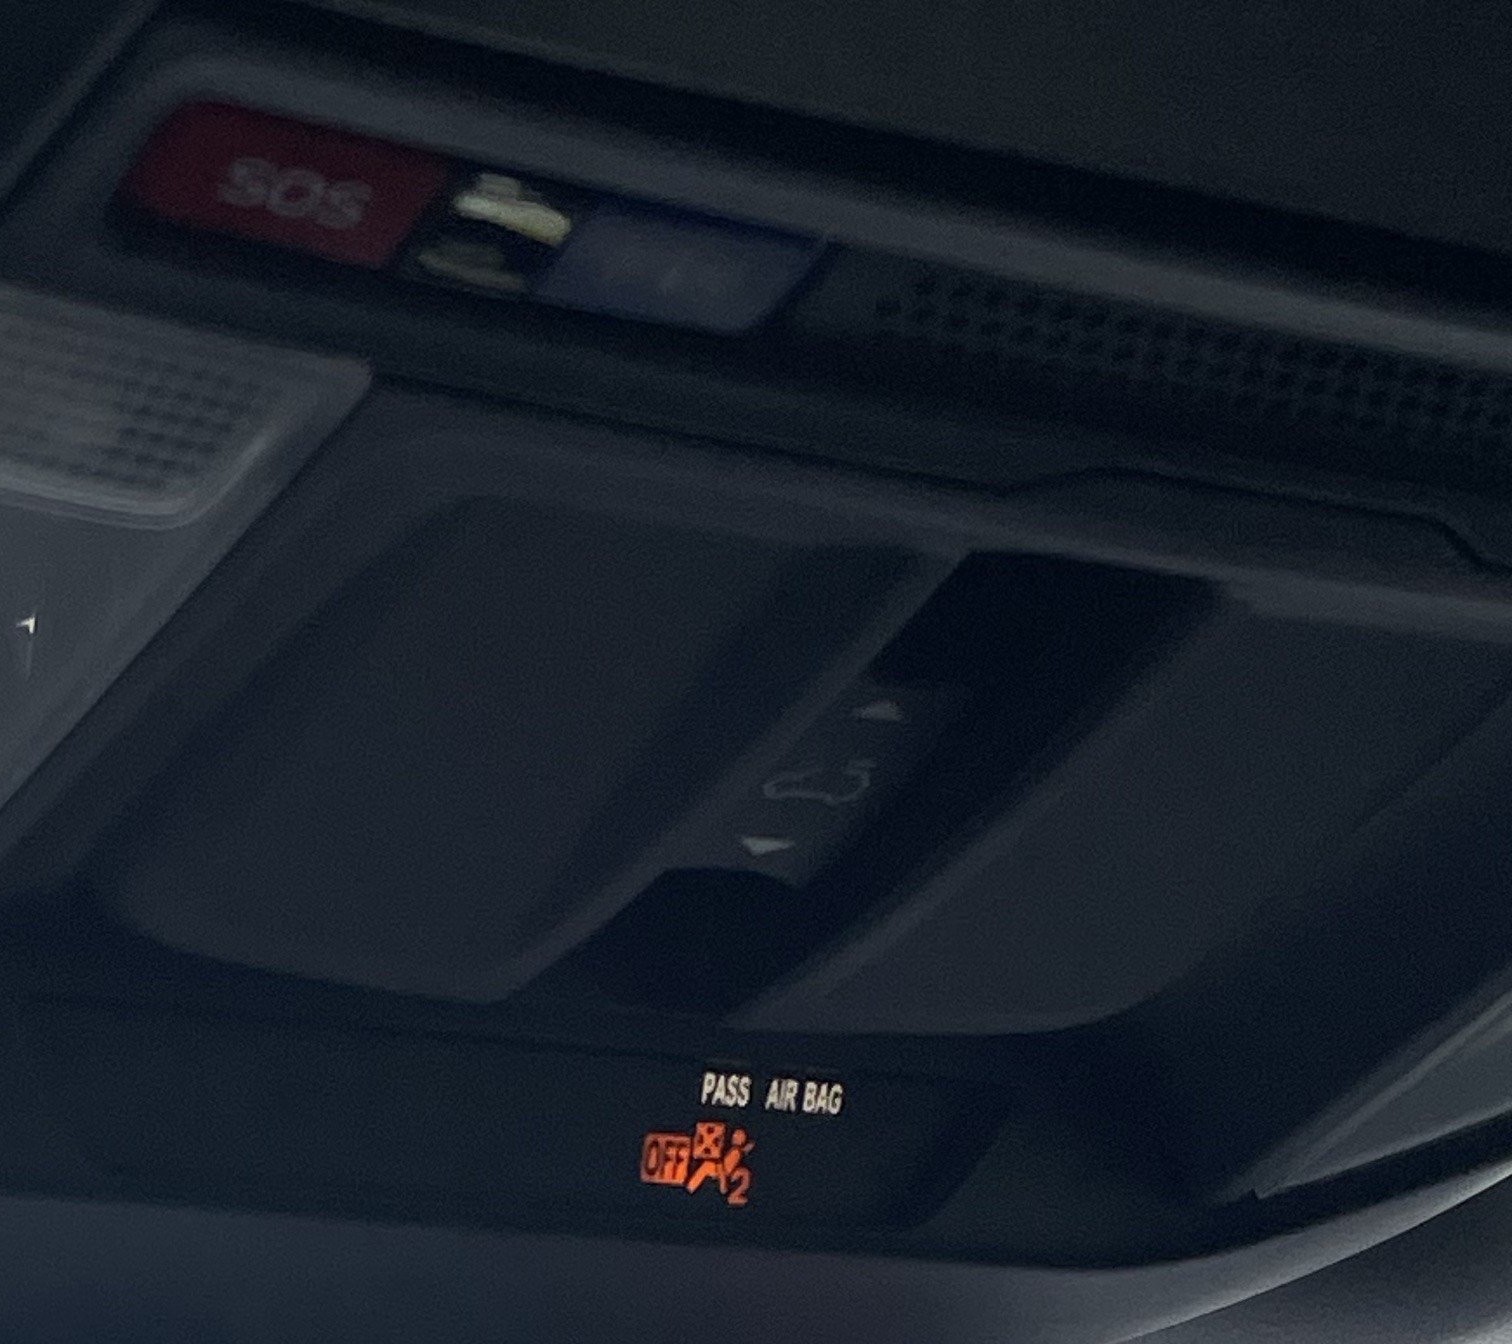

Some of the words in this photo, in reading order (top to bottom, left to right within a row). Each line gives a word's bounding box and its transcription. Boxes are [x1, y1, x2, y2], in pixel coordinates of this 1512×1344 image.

[219, 157, 373, 231] SOS
[700, 1070, 753, 1109] PASS
[764, 1077, 800, 1113] AIR
[801, 1081, 845, 1116] BAG
[644, 1137, 690, 1182] OFF
